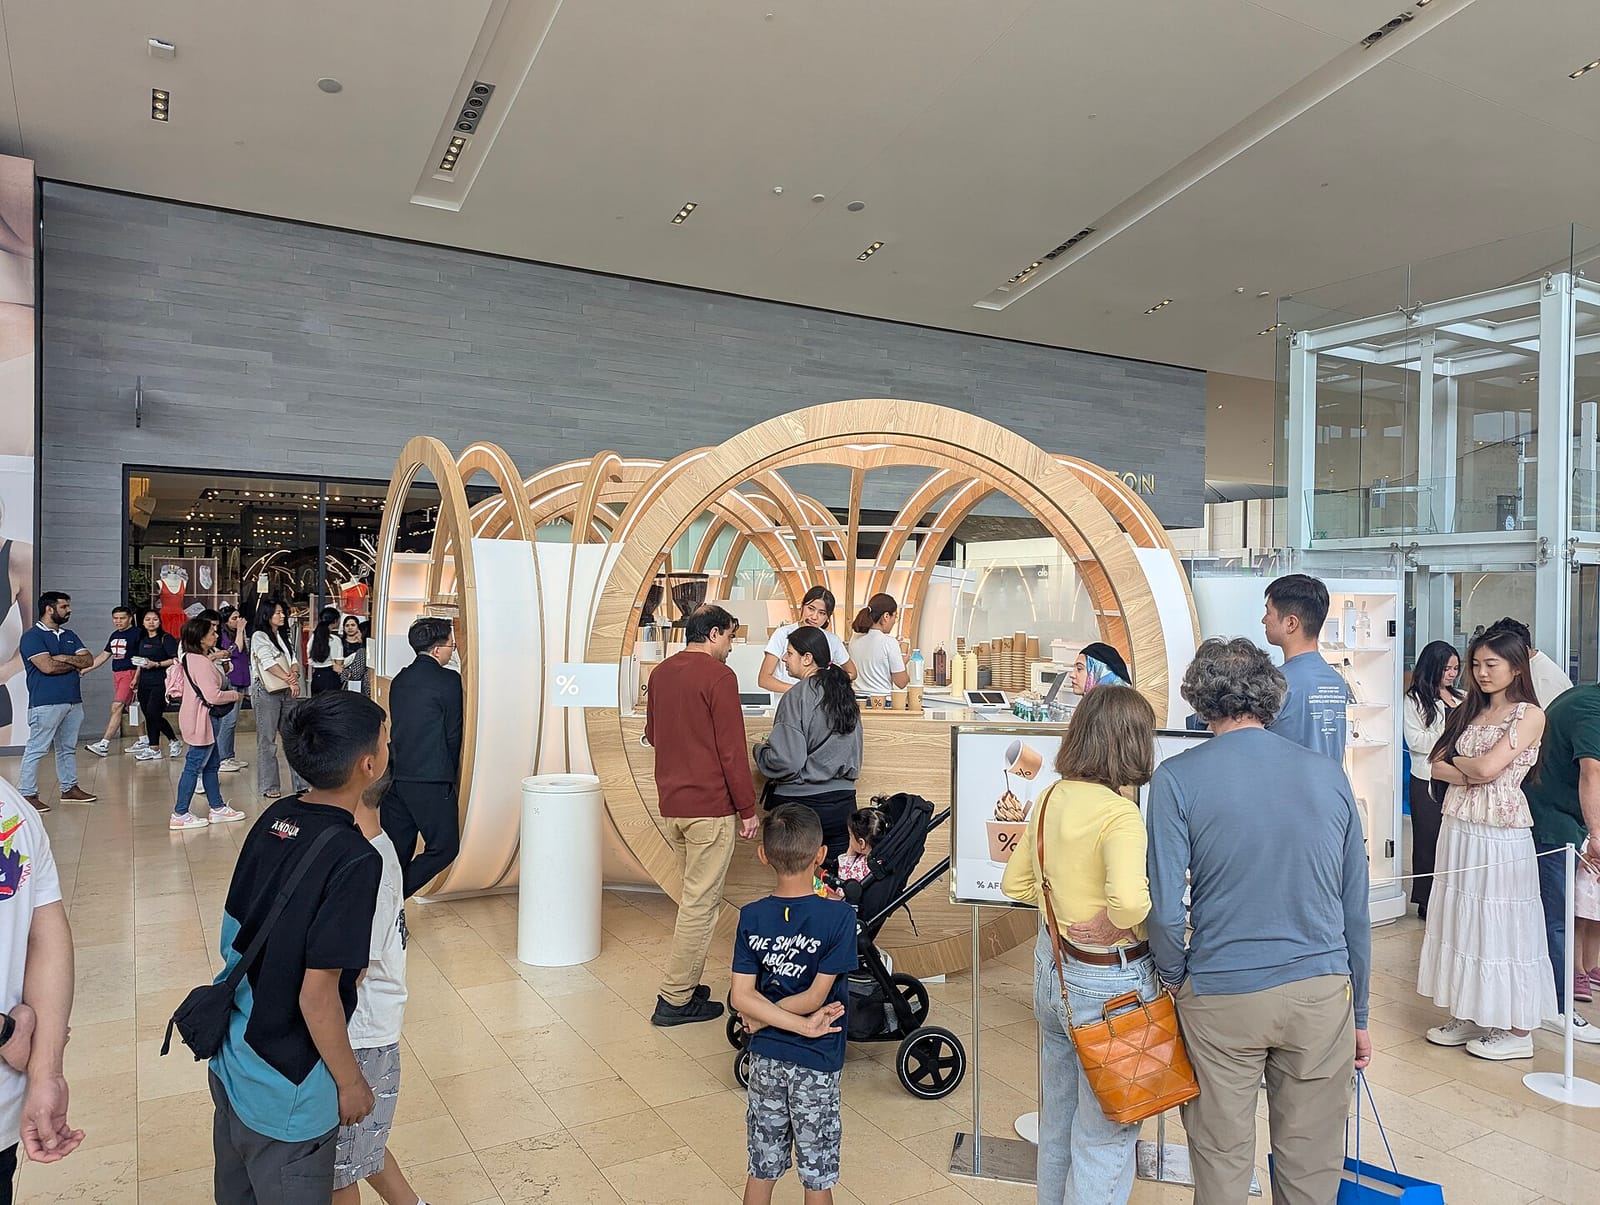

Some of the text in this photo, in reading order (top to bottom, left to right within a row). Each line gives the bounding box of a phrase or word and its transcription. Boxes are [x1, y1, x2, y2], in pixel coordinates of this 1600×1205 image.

[976, 880, 985, 889] %
[749, 935, 771, 951] THE
[762, 948, 799, 966] ABOT
